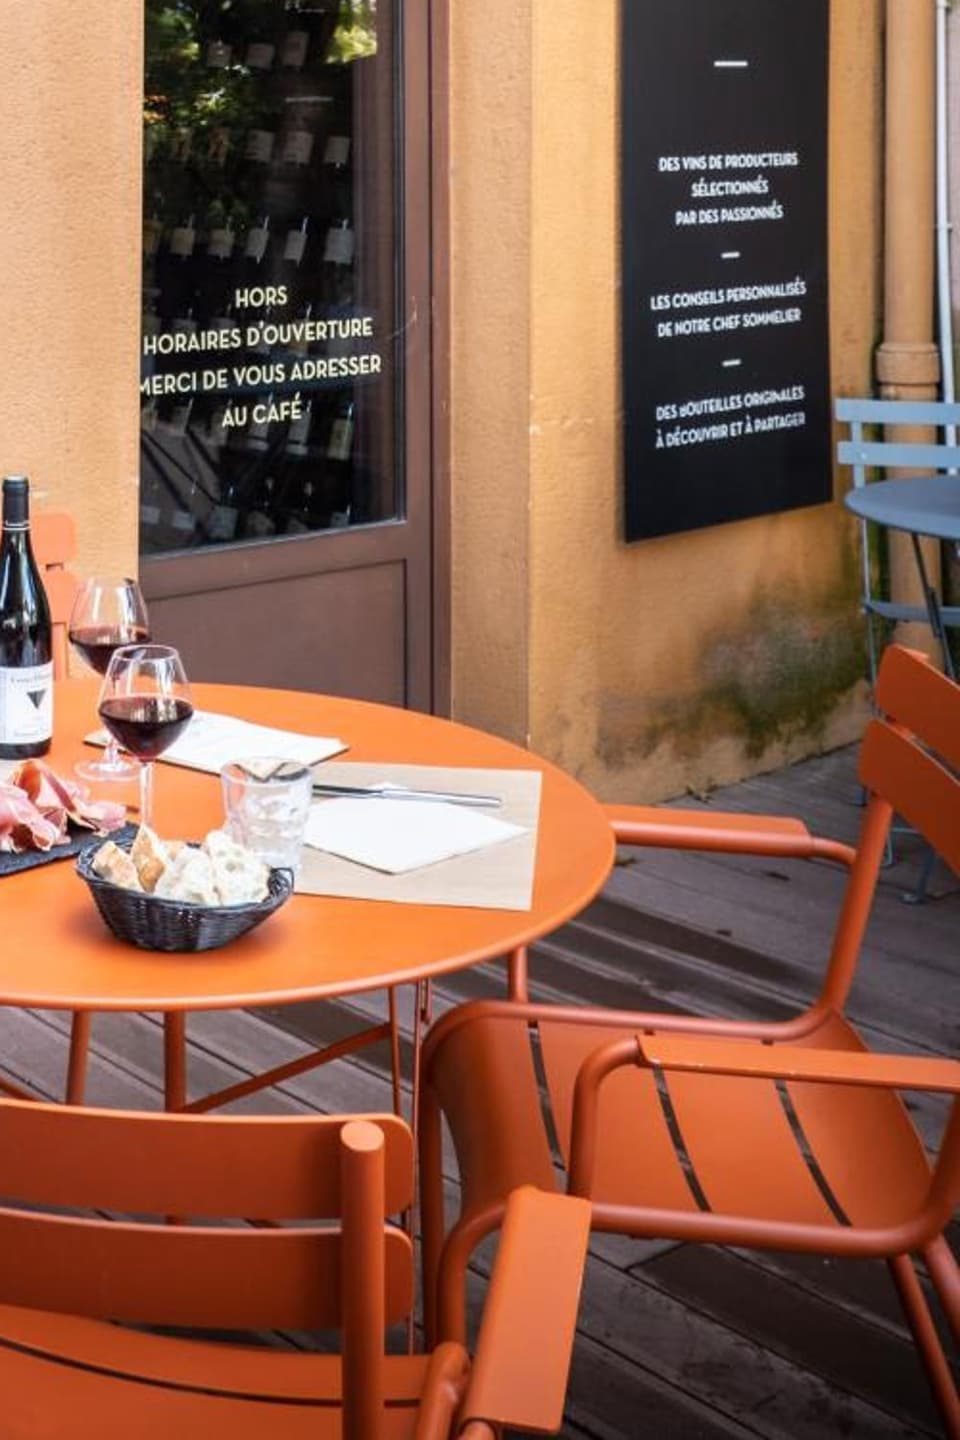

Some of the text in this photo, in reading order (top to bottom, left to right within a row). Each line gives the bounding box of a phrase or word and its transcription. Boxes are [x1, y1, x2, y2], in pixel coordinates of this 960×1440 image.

[658, 152, 798, 172] DES VINS DE PRODUCTEURS
[691, 174, 769, 197] SÉLECTIONNÉS
[675, 199, 784, 225] PAR DES PASSIONNÉS
[235, 286, 288, 308] HORS
[650, 275, 807, 310] LES CONSEILS PERSONNALISÉS
[143, 317, 373, 356] HORAIRES D'OUVERTURE
[657, 308, 801, 337] DE NOTRE CHEF SOMMELIER
[203, 368, 228, 390] DE
[233, 363, 285, 386] VOUS
[291, 355, 381, 381] ADRESSER
[221, 391, 302, 428] AU CAFÉ
[656, 404, 677, 421] DES
[744, 385, 805, 407] ORIGINALES
[666, 424, 728, 448] DÉCOUVRIR
[730, 421, 742, 437] ET
[754, 412, 805, 432] PARTAGER
